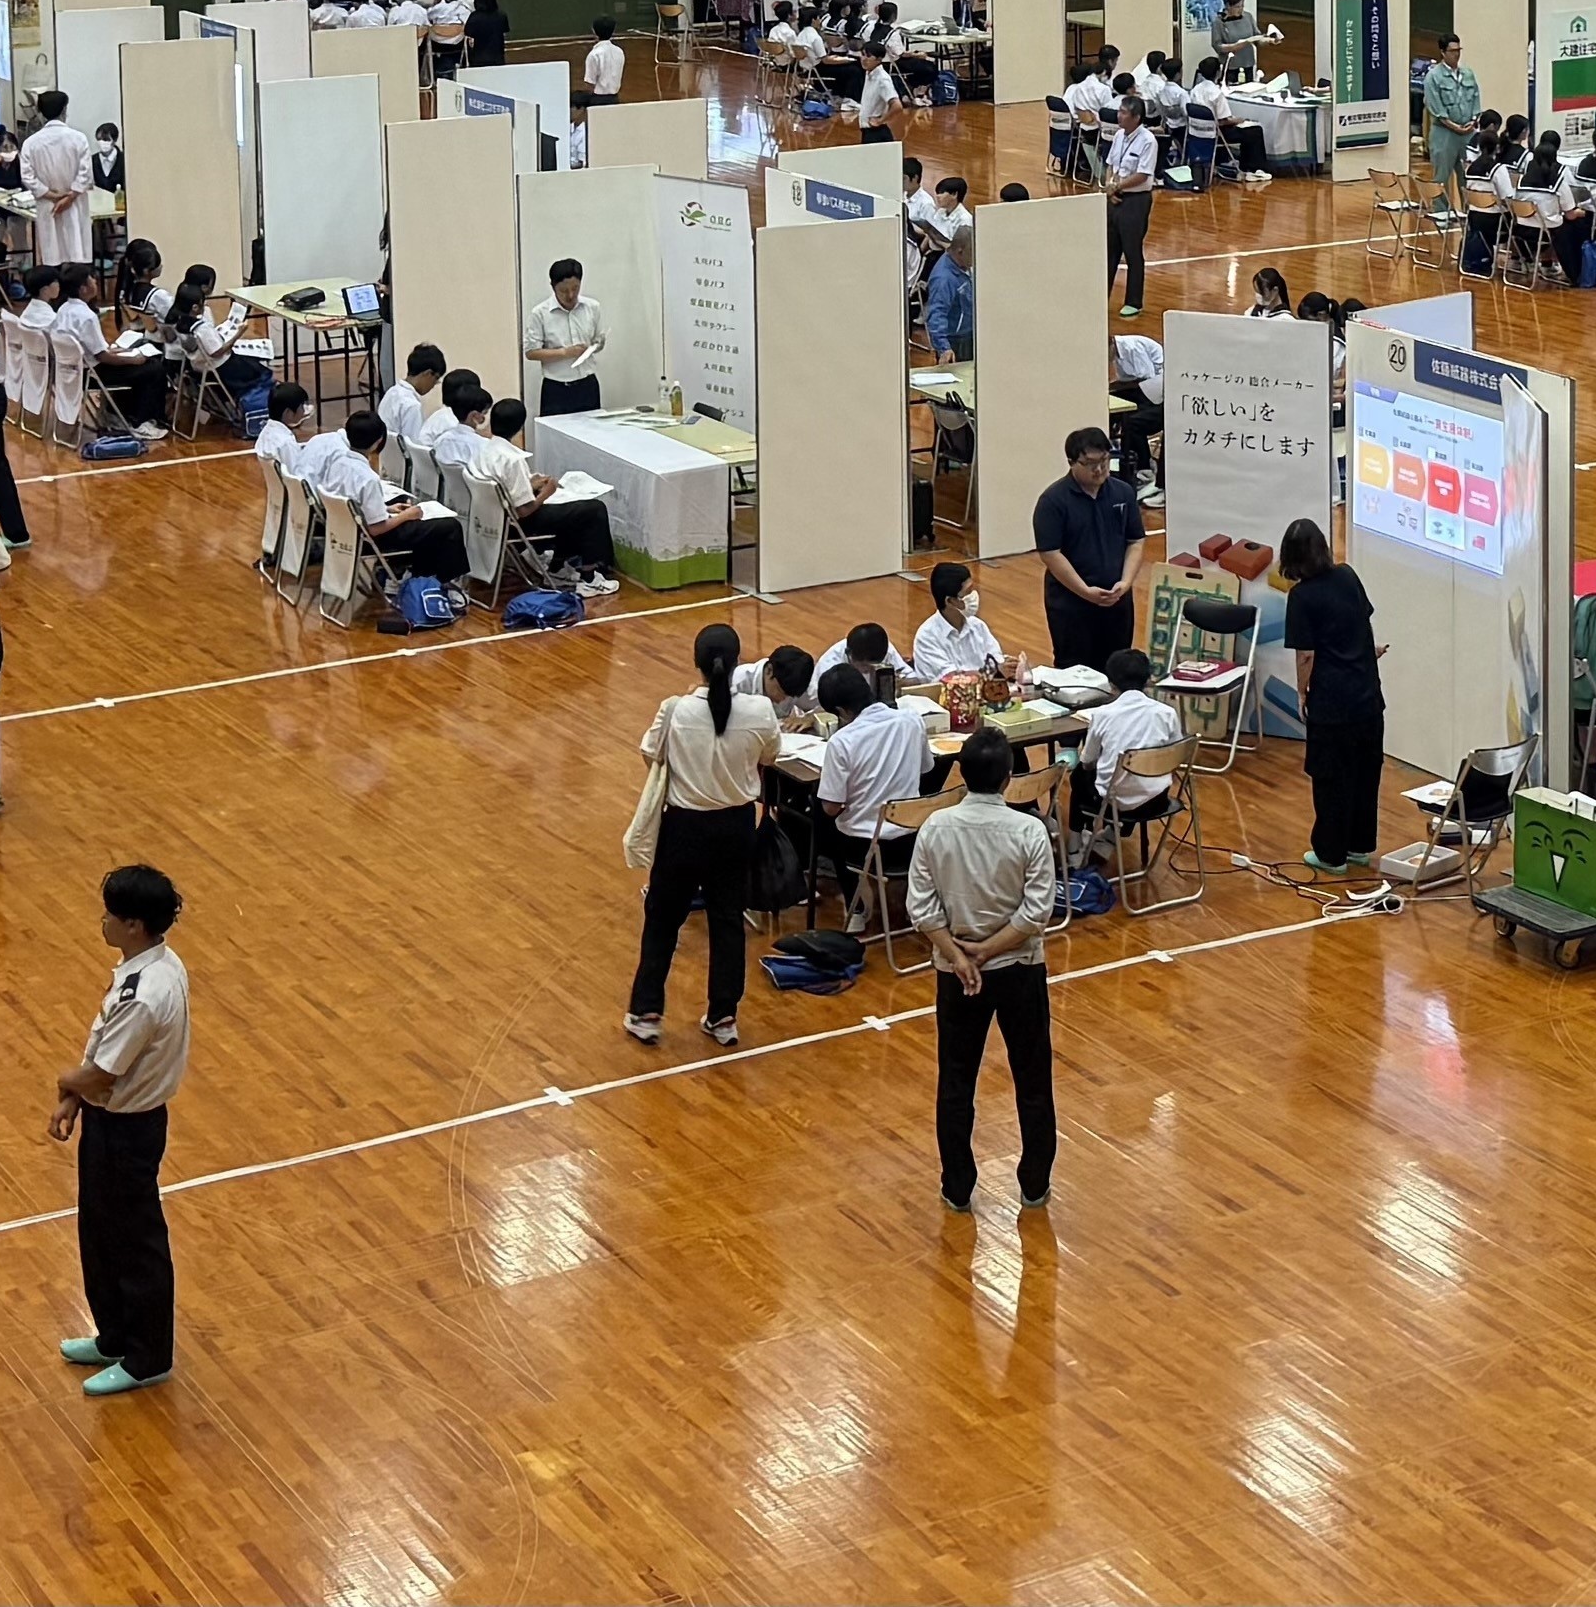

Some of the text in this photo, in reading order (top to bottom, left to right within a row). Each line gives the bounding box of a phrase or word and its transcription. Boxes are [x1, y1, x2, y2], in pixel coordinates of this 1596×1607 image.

[1389, 343, 1406, 366] 20
[1431, 357, 1503, 392] 佐藤紙器株式会
[1181, 394, 1276, 423] 「欲しい」を
[1183, 428, 1316, 458] カタチにします
